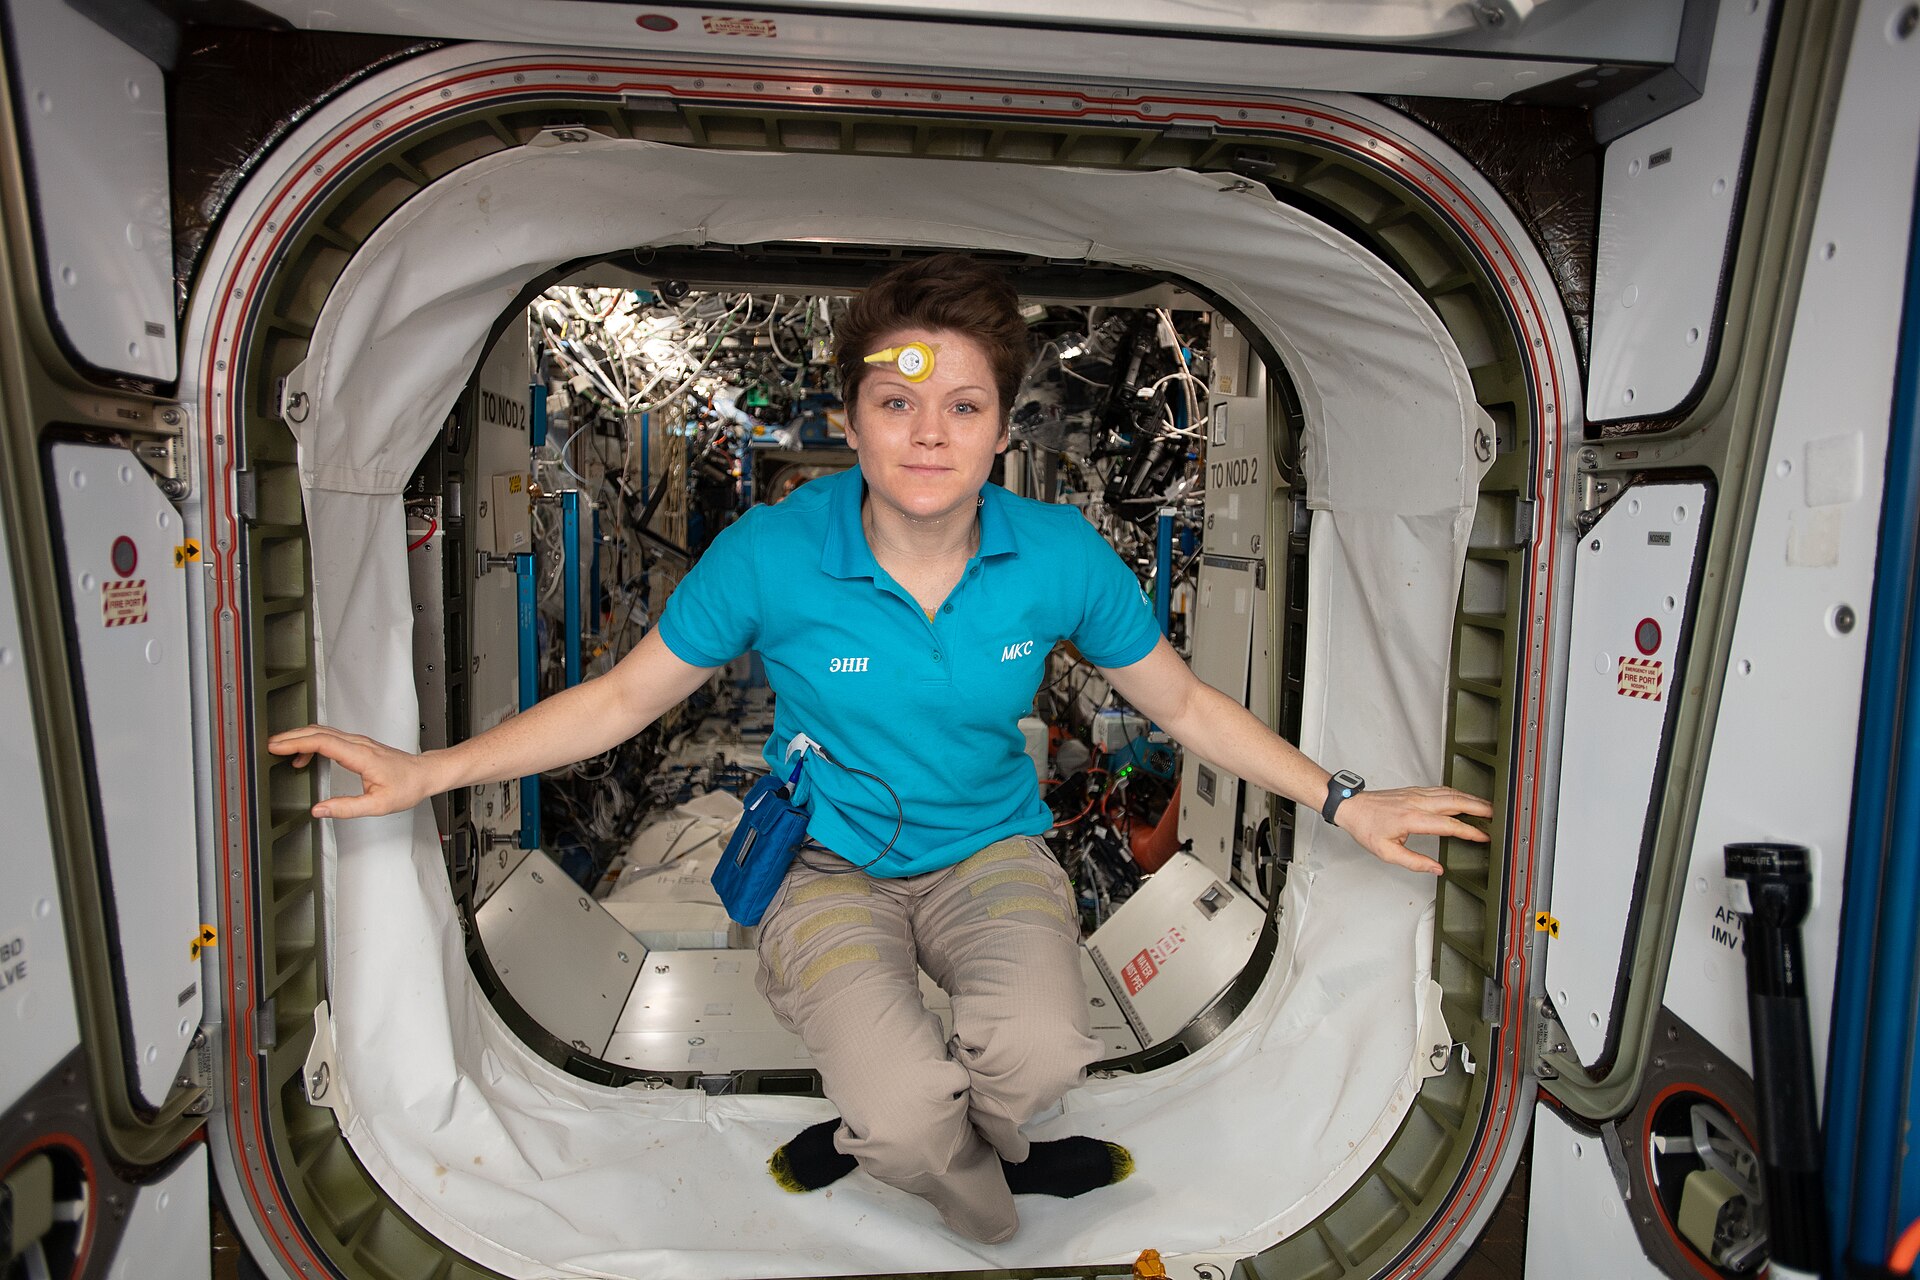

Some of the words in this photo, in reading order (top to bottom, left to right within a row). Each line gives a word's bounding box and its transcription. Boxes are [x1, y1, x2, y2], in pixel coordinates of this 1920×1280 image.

[482, 391, 496, 423] TO
[498, 396, 518, 428] NOD
[520, 404, 525, 430] 2
[1211, 463, 1224, 489] TO
[1226, 459, 1249, 487] NOD
[1251, 457, 1258, 484] 2
[109, 600, 124, 608] FIRE
[126, 598, 141, 607] PORT
[1001, 640, 1034, 663] МКС
[829, 657, 870, 673] ЭНН
[1625, 666, 1648, 674] EMERGENCY
[1624, 673, 1638, 682] FIRE
[1639, 675, 1656, 685] PORT
[1715, 906, 1743, 930] AFT
[1711, 925, 1738, 950] IMV
[1136, 953, 1154, 980] WATER
